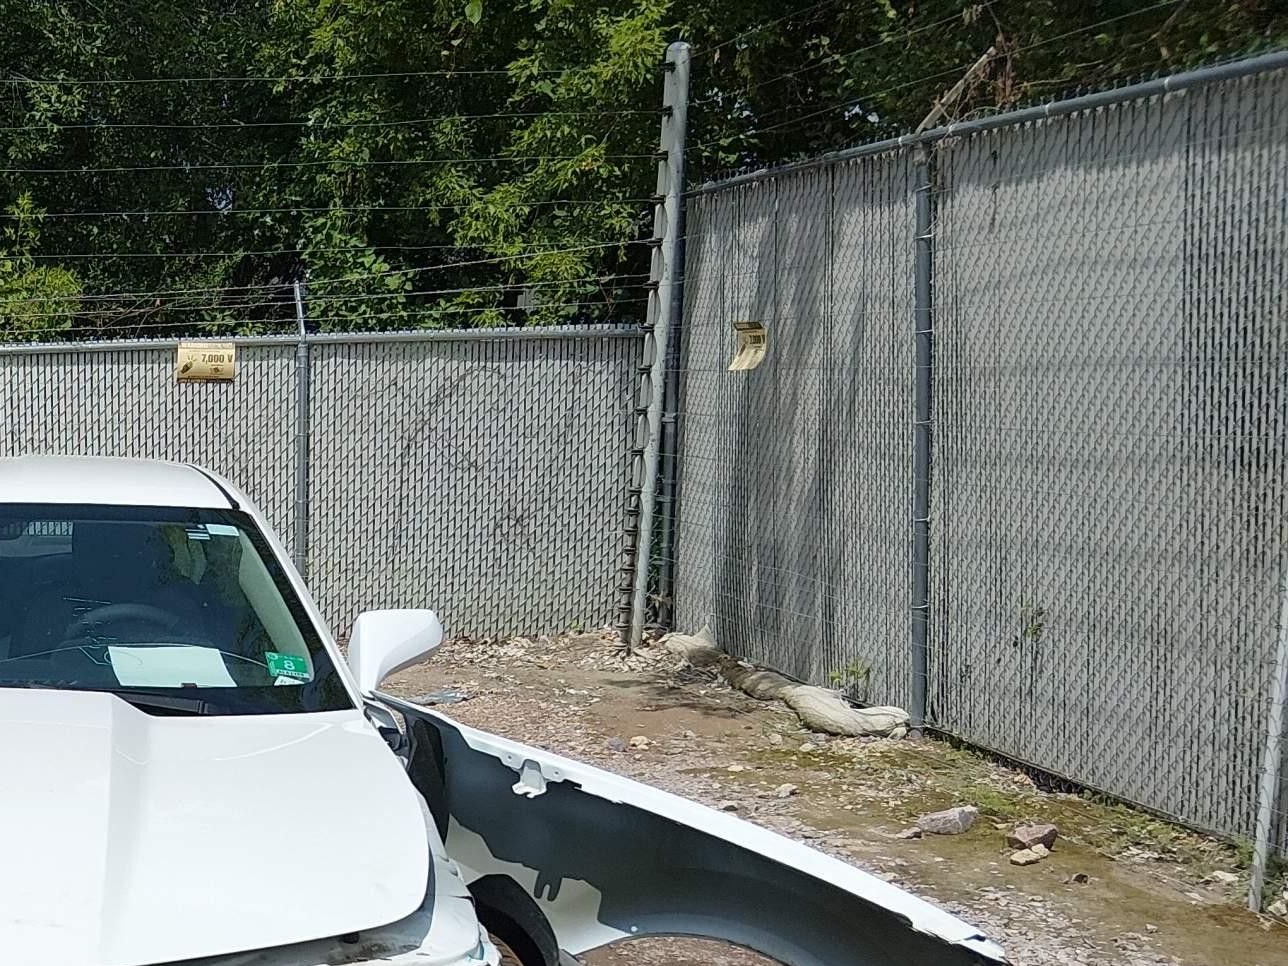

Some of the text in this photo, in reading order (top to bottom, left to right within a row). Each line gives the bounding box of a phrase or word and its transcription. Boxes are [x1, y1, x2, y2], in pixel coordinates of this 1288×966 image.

[201, 354, 233, 365] 7,000 V
[283, 659, 296, 671] 8
